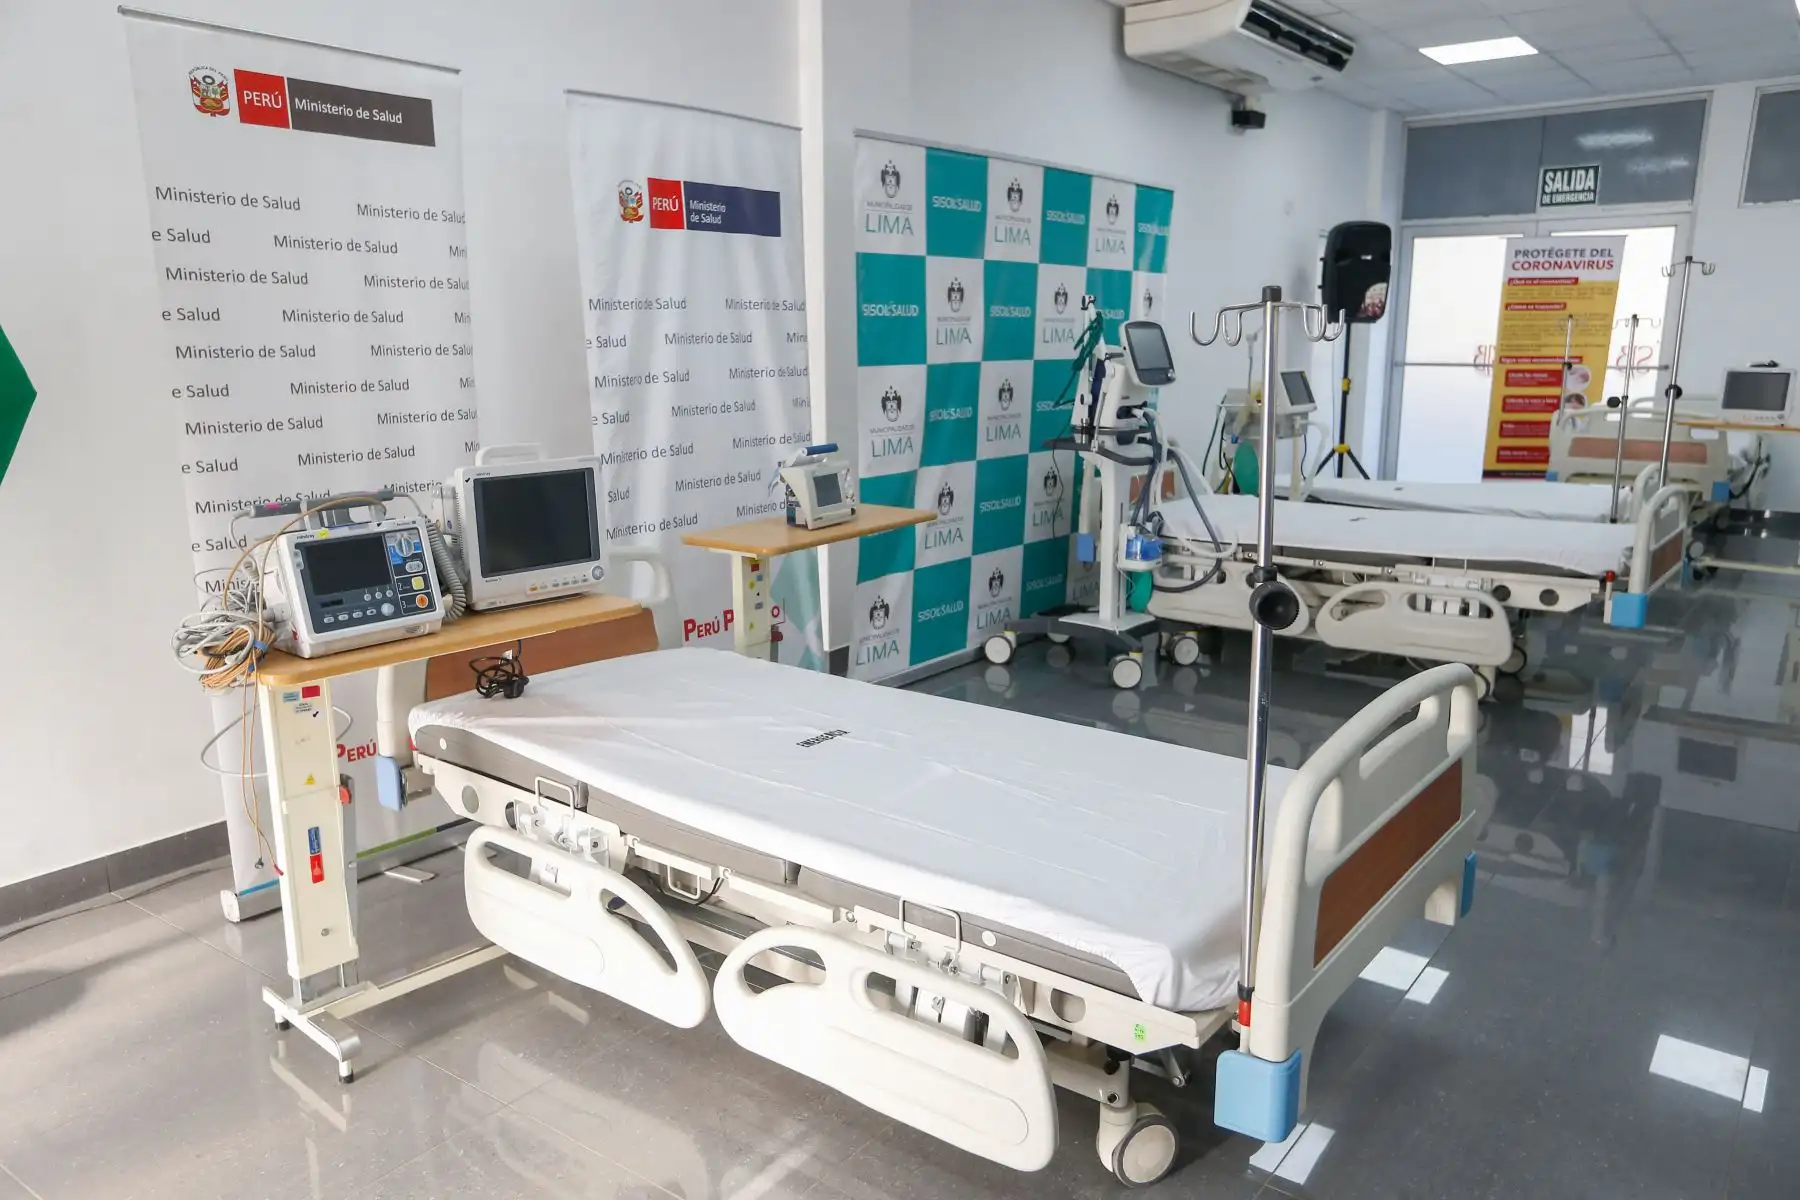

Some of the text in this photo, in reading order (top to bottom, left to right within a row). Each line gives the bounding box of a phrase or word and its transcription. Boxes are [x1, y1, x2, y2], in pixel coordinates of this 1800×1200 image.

[243, 86, 282, 109] PERÚ
[295, 97, 402, 124] Ministerio de Salud
[1544, 168, 1595, 194] SALIDA
[155, 186, 300, 211] Ministerio de Salud
[652, 196, 678, 211] PERÚ
[690, 200, 726, 213] Ministerio
[1542, 192, 1594, 204] DE EMERGENCIA
[357, 204, 420, 220] Ministerio
[423, 208, 438, 222] de
[690, 213, 722, 224] de Salud
[866, 213, 914, 236] LIMA
[167, 228, 211, 244] Salud
[274, 234, 398, 254] Ministerio de Salud
[994, 226, 1031, 246] LIMA
[1095, 237, 1126, 254] LIMA
[1514, 246, 1614, 259] PROTÉGETE DEL
[1512, 260, 1614, 272] CORONAVIRUS
[166, 266, 308, 285] Ministerio de Salud
[364, 274, 426, 289] Ministerio
[429, 276, 444, 290] de
[588, 298, 644, 311] Ministerio
[656, 298, 687, 310] Salud
[725, 298, 772, 310] Ministerio
[177, 307, 220, 322] Salud
[282, 309, 404, 324] Ministerio de Salud
[596, 335, 627, 348] Salud
[665, 332, 752, 345] Ministerio de Salud
[936, 327, 972, 346] LIMA
[1042, 327, 1076, 344] LIMA
[176, 344, 316, 359] Ministerio de Salud
[370, 343, 432, 357] Ministerio
[435, 343, 450, 356] de
[644, 372, 659, 384] de
[663, 370, 690, 383] Salud
[729, 367, 808, 380] Ministerio de Salud
[186, 384, 230, 398] Salud
[290, 379, 410, 396] Ministerio de Salud
[672, 400, 756, 417] Ministerio de Salud
[185, 416, 324, 436] Ministerio de Salud
[377, 410, 437, 426] Ministerio
[440, 409, 455, 422] de
[602, 411, 630, 424] Salud
[732, 434, 776, 449] Ministerio
[779, 433, 792, 445] de
[986, 423, 1022, 442] LIMA
[601, 443, 694, 466] Ministerio de Salud
[872, 436, 914, 458] LIMA
[298, 446, 416, 466] Ministerio de Salud
[196, 458, 238, 474] Salud
[675, 471, 761, 492] Ministerio de Salud
[608, 488, 630, 503] Salud
[736, 503, 777, 518] Ministerio
[1032, 507, 1064, 527] LIMA
[606, 514, 698, 540] Ministerio de Salud
[206, 535, 248, 551] Salud
[924, 527, 964, 550] LIMA
[976, 607, 1012, 630] LIMA
[684, 616, 720, 642] PERÚ
[856, 640, 900, 666] LIMA
[336, 738, 377, 762] PERÚ
